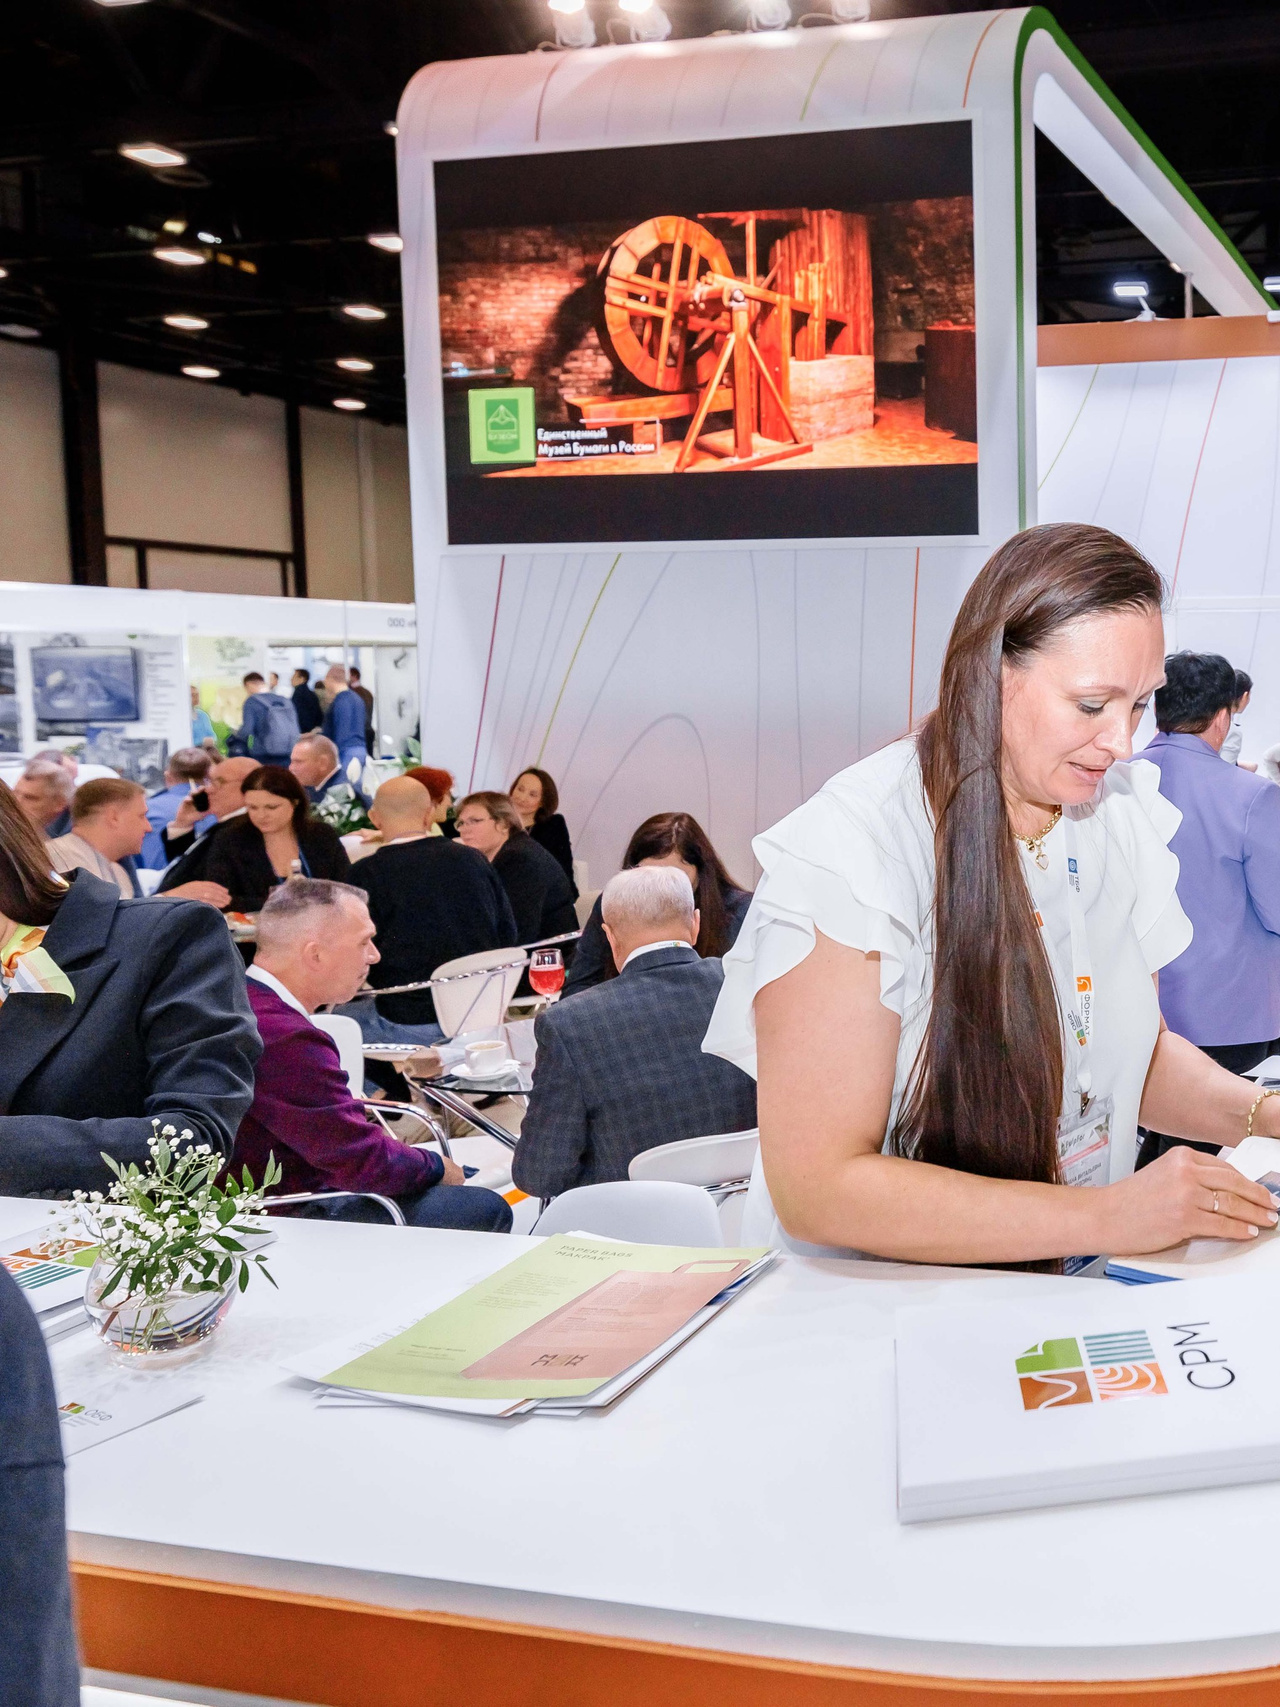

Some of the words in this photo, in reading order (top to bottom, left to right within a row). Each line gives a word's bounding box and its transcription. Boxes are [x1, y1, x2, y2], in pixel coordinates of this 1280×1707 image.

[536, 427, 608, 441] Единственный
[537, 442, 571, 457] Музей
[572, 441, 609, 457] Бумаги
[610, 444, 618, 453] в
[618, 440, 655, 453] России
[560, 1245, 599, 1255] PAPER
[1166, 1321, 1236, 1390] CPM
